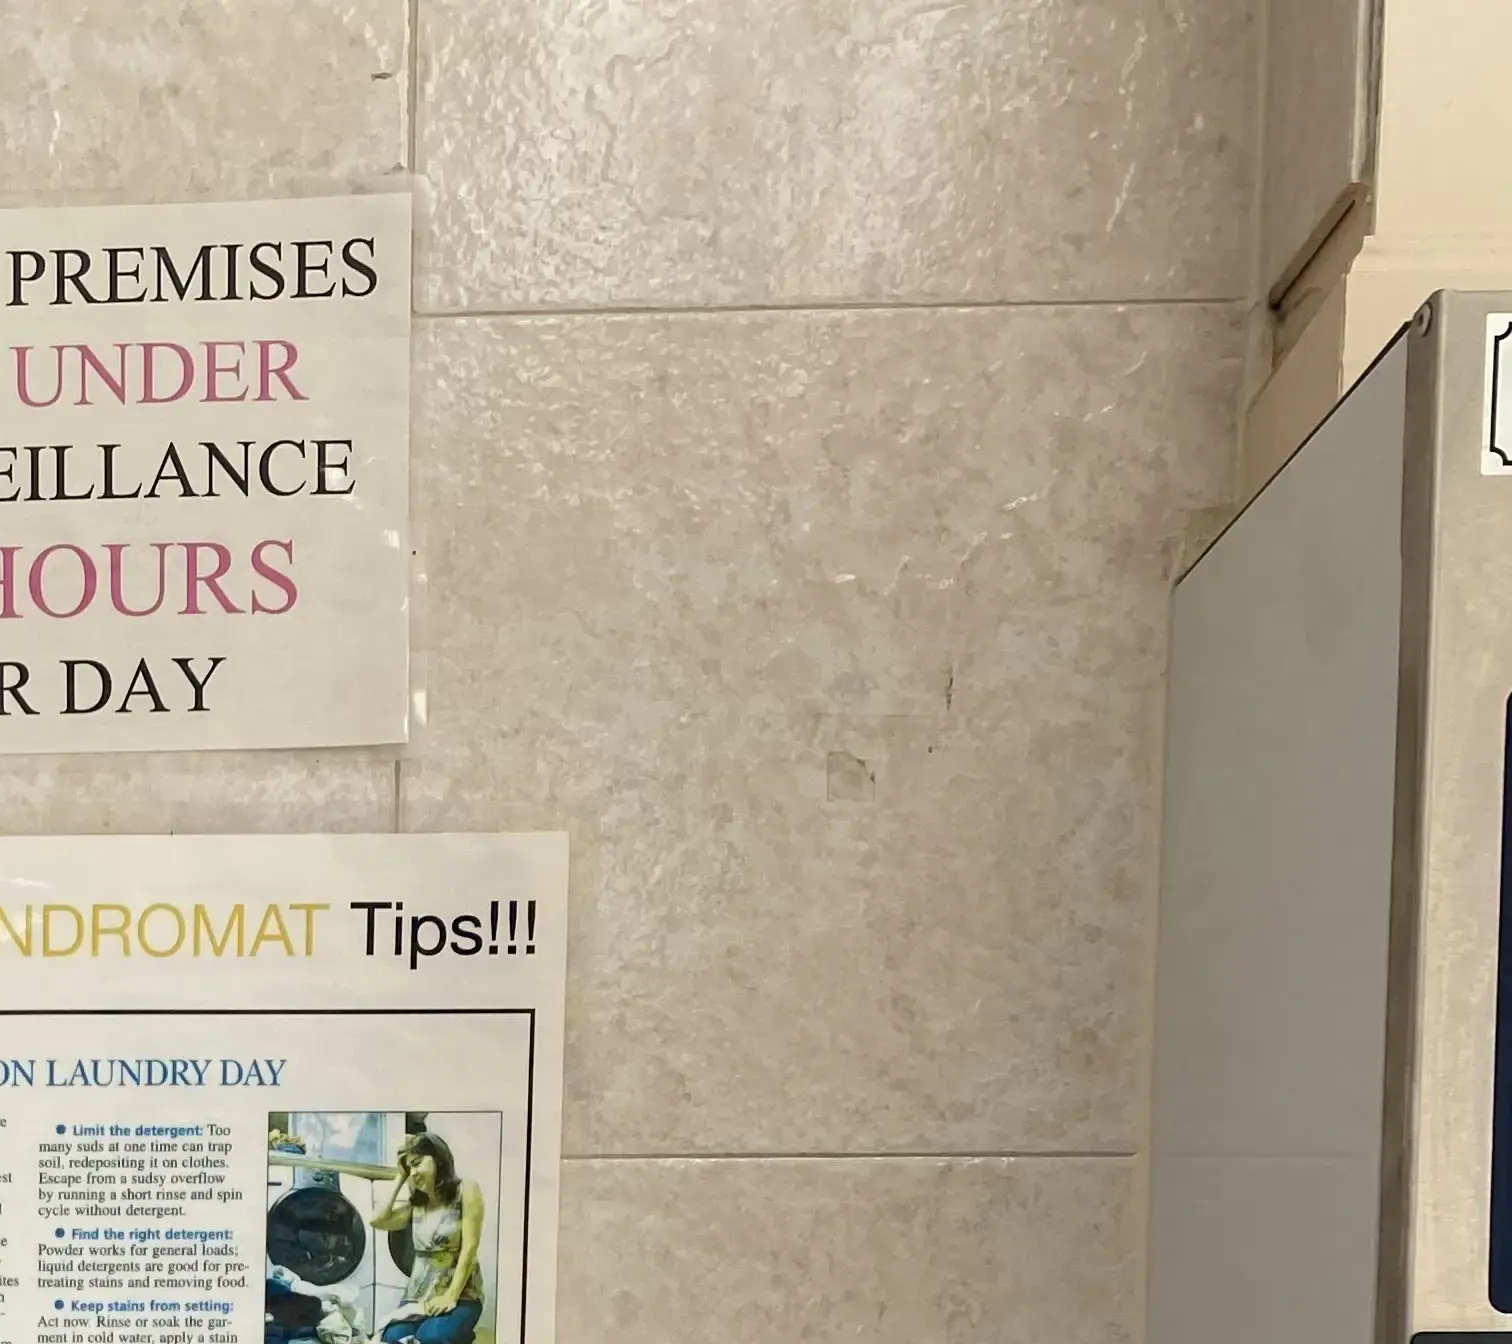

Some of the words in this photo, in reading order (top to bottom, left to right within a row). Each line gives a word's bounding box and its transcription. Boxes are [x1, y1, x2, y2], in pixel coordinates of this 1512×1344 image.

[6, 237, 377, 306] PREMISES
[9, 340, 310, 407] UNDER
[59, 657, 226, 714] DAY
[350, 900, 536, 970] Tips!!!
[46, 1059, 212, 1086] LAUNDRY
[220, 1059, 287, 1086] DAY
[73, 1125, 105, 1136] Limit
[109, 1124, 131, 1136] the
[135, 1124, 203, 1139] detergent:
[207, 1124, 231, 1136] Too
[72, 1228, 99, 1240] Find
[104, 1228, 124, 1240] the
[129, 1228, 160, 1243] right
[165, 1228, 233, 1243] detergent:
[71, 1300, 104, 1315] Keep
[108, 1300, 145, 1312] stains
[150, 1299, 180, 1312] from
[185, 1300, 234, 1315] setting:
